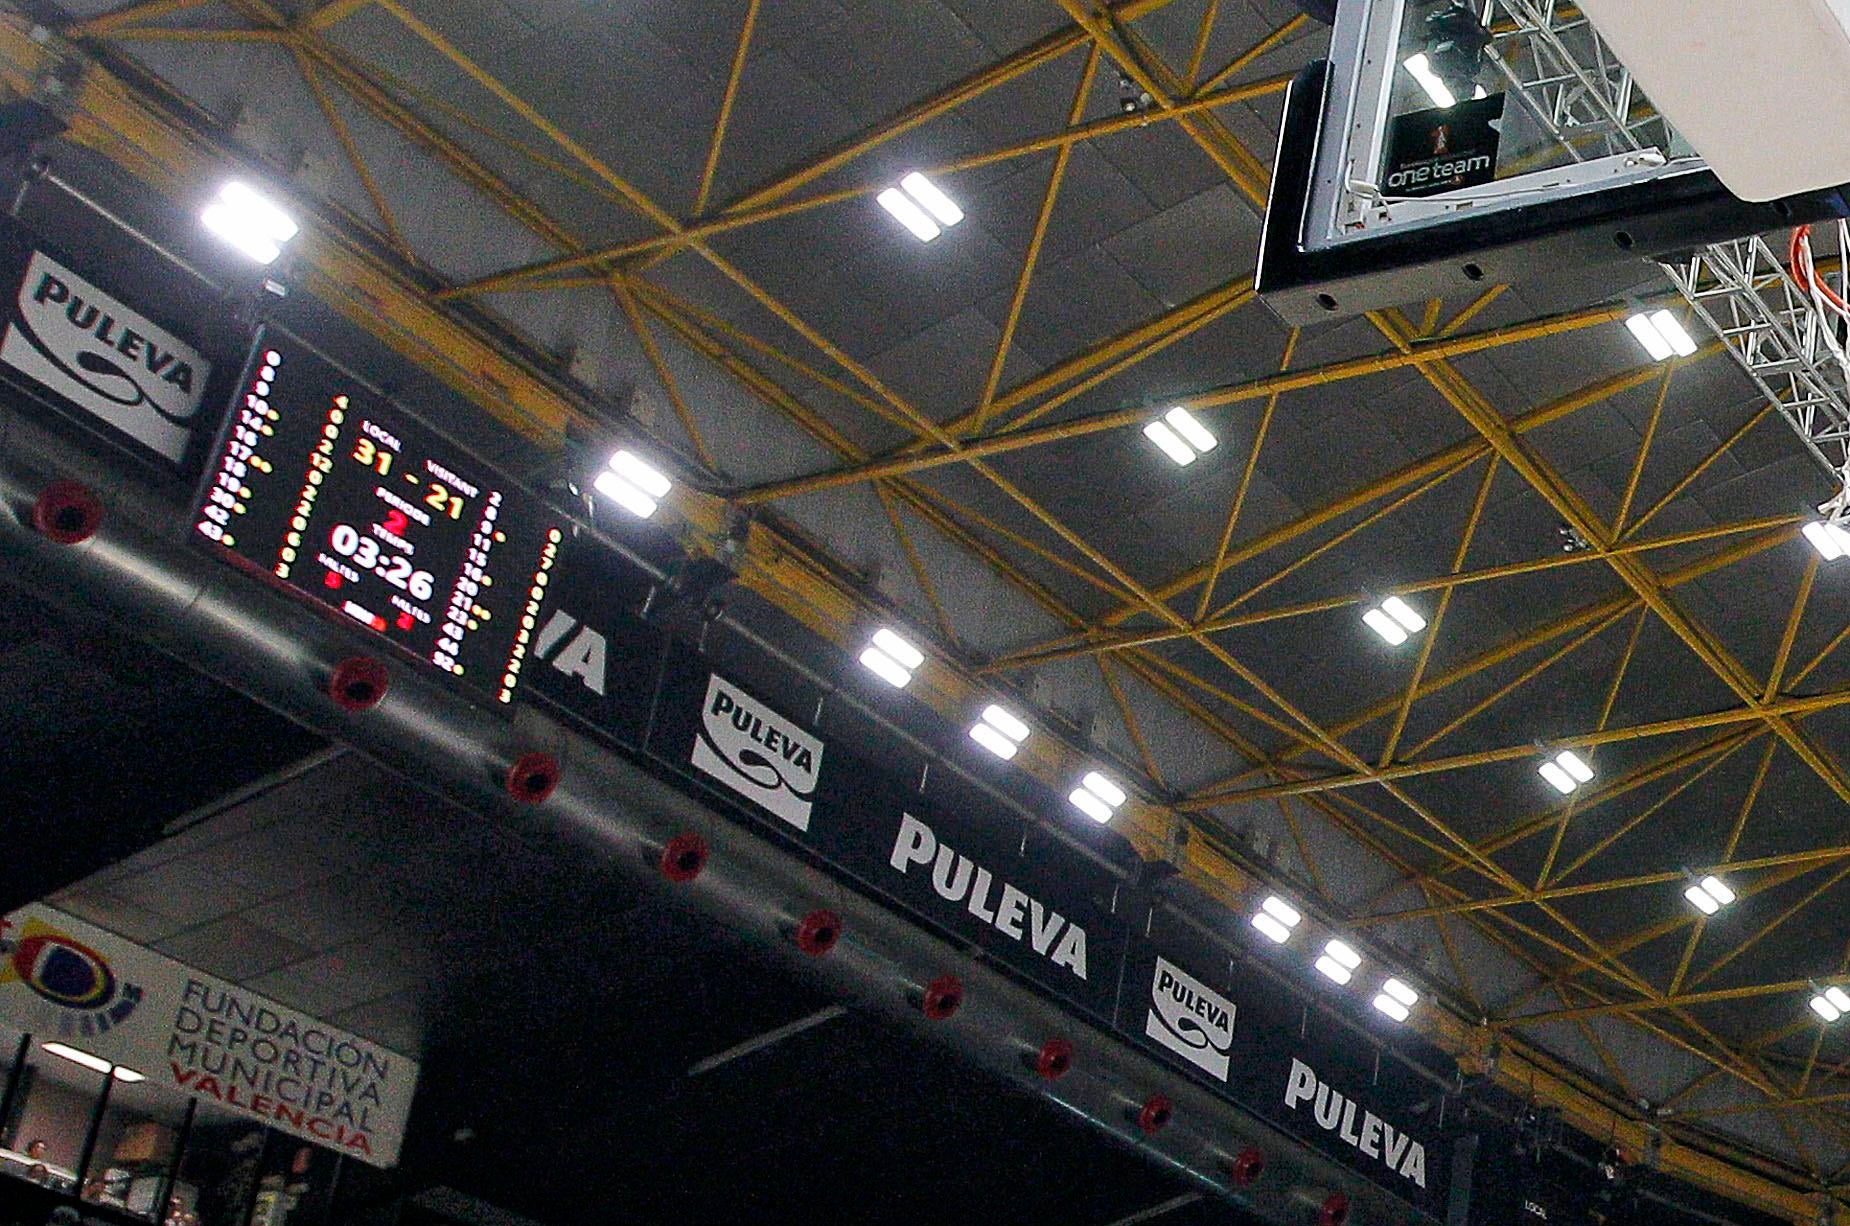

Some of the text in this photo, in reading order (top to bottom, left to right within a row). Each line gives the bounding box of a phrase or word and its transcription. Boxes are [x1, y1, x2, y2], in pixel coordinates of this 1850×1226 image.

[33, 271, 192, 394] PULEVA
[328, 409, 344, 425] 0
[323, 424, 339, 439] 0
[361, 420, 402, 453] LOCAL
[229, 441, 253, 461] 17
[317, 439, 334, 455] 2
[310, 452, 334, 474] 12
[307, 470, 323, 485] 0
[353, 438, 393, 475] 31
[425, 483, 464, 519] 21
[210, 486, 236, 508] 30
[302, 485, 318, 501] 2
[297, 500, 313, 517] 2
[291, 515, 307, 531] 0
[548, 528, 562, 543] 0
[281, 547, 296, 562] 0
[543, 543, 557, 558] 2
[331, 524, 435, 600] 03:26
[455, 576, 479, 597] 20
[534, 571, 548, 586] 0
[530, 585, 544, 600] 0
[525, 600, 539, 616] 2
[521, 615, 535, 629] 0
[503, 673, 517, 688] 0
[711, 689, 812, 774] PULEVA
[890, 812, 1087, 980] PULEVA
[1158, 970, 1229, 1033] PULEVA
[185, 977, 389, 1080] FUNDACIÓN
[175, 1006, 379, 1107] DEPORTIVA
[169, 1033, 372, 1134] MUNICIPAL
[170, 1061, 371, 1156] VALENCIA
[1284, 1057, 1426, 1189] PULEVA
